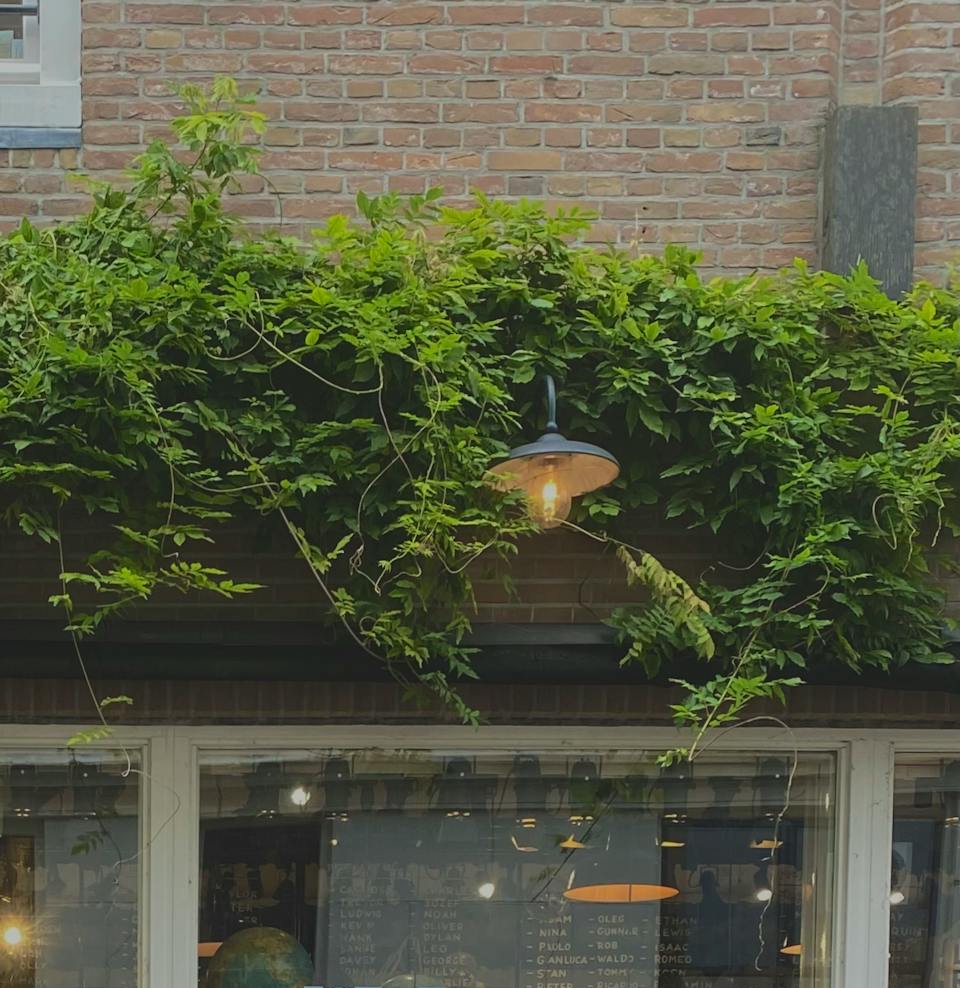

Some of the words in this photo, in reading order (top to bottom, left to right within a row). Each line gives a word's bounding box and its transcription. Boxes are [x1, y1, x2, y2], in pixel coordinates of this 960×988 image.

[423, 910, 457, 920] NOAH
[539, 927, 567, 937] NINA
[423, 944, 448, 953] LEO
[597, 941, 618, 950] ROB
[536, 954, 589, 966] GANLUCA
[654, 954, 693, 964] ROMEO
